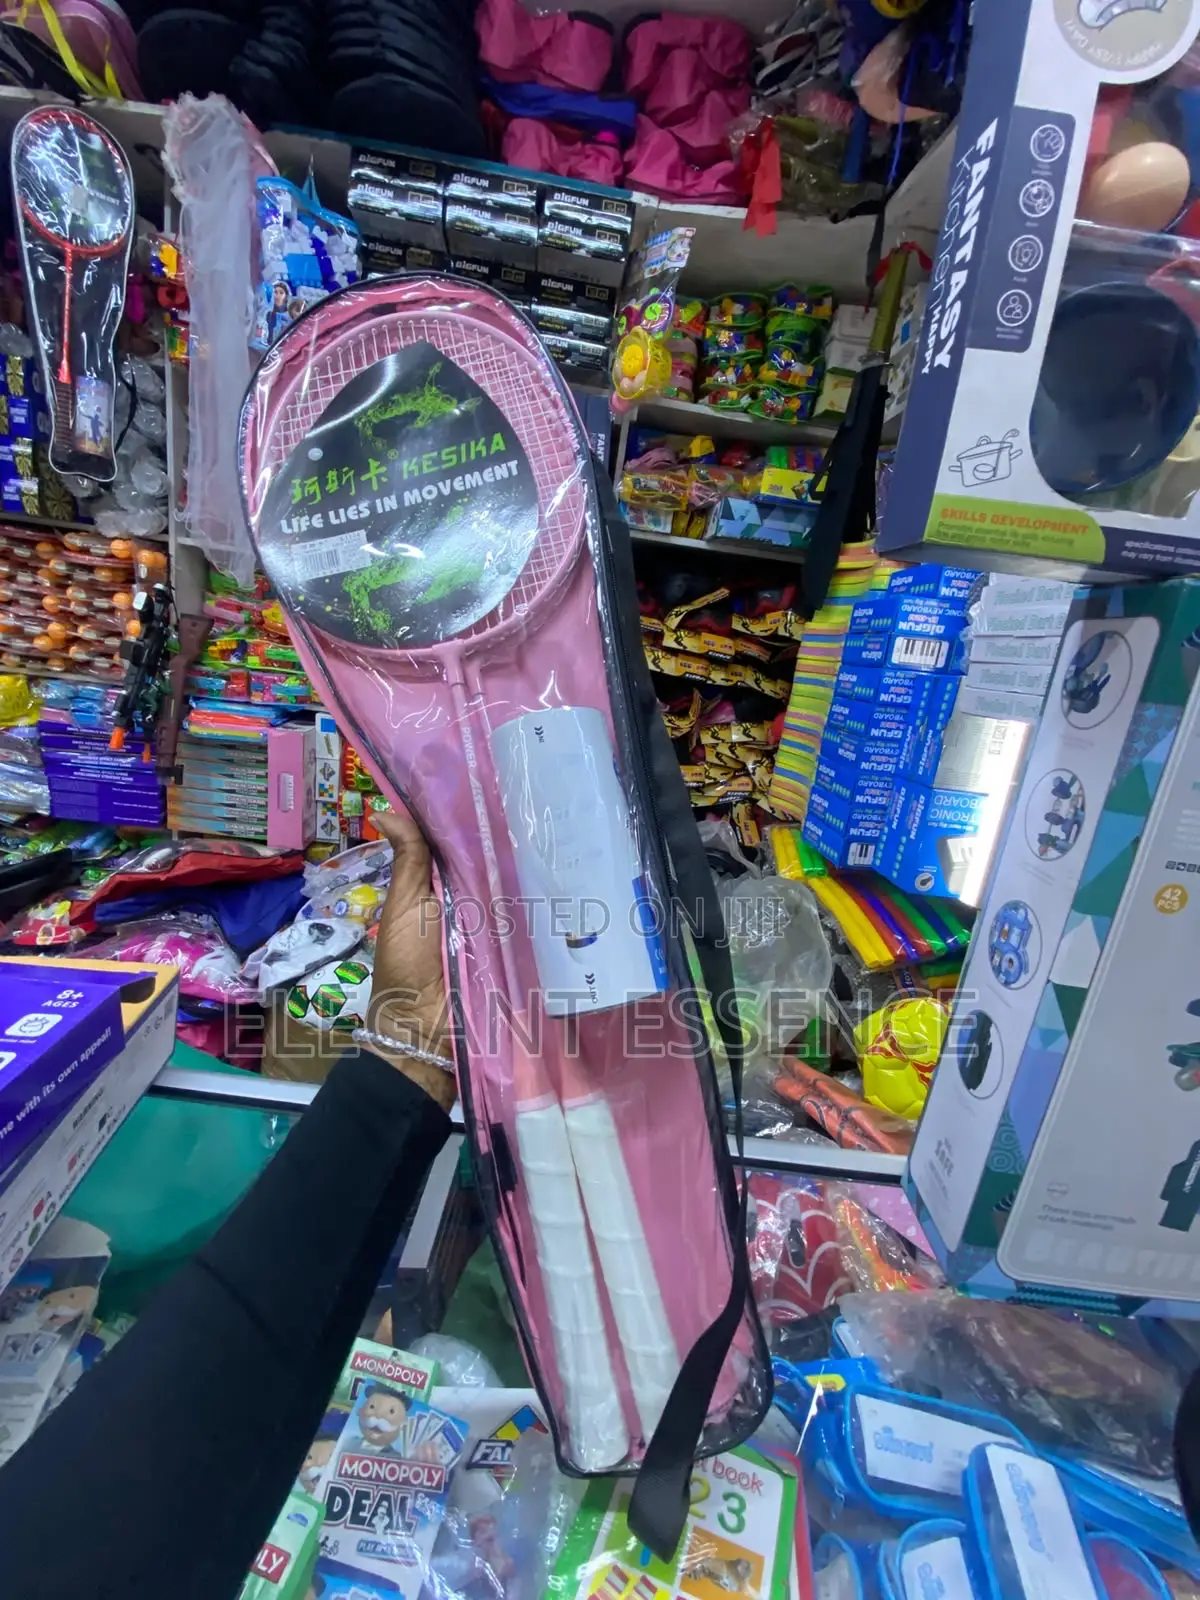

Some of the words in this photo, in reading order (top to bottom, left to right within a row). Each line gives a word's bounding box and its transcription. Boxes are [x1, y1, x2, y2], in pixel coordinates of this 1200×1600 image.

[933, 117, 998, 369] FANTASY
[402, 431, 506, 481] KESIKA
[280, 514, 325, 535] LIFE
[329, 502, 371, 526] LIES
[375, 494, 399, 515] IN
[403, 459, 520, 508] MOVEMENT
[941, 507, 987, 523] SKILLS
[990, 514, 1090, 535] DEVELOPMENT
[462, 726, 478, 769] POWER
[1156, 899, 1181, 910] PCS
[1162, 887, 1182, 900] 42
[41, 1000, 79, 1009] AGES
[56, 989, 84, 1000] 8+
[591, 985, 599, 1004] OUT
[15, 1095, 41, 1122] with
[42, 1081, 56, 1098] its
[57, 1060, 79, 1083] own
[80, 1025, 112, 1063] appeal!
[355, 1356, 425, 1386] MONOPOLY
[340, 1457, 444, 1488] MONOPOLY
[713, 1456, 765, 1497] book
[324, 1482, 418, 1536] DEAL
[716, 1490, 748, 1535] 3
